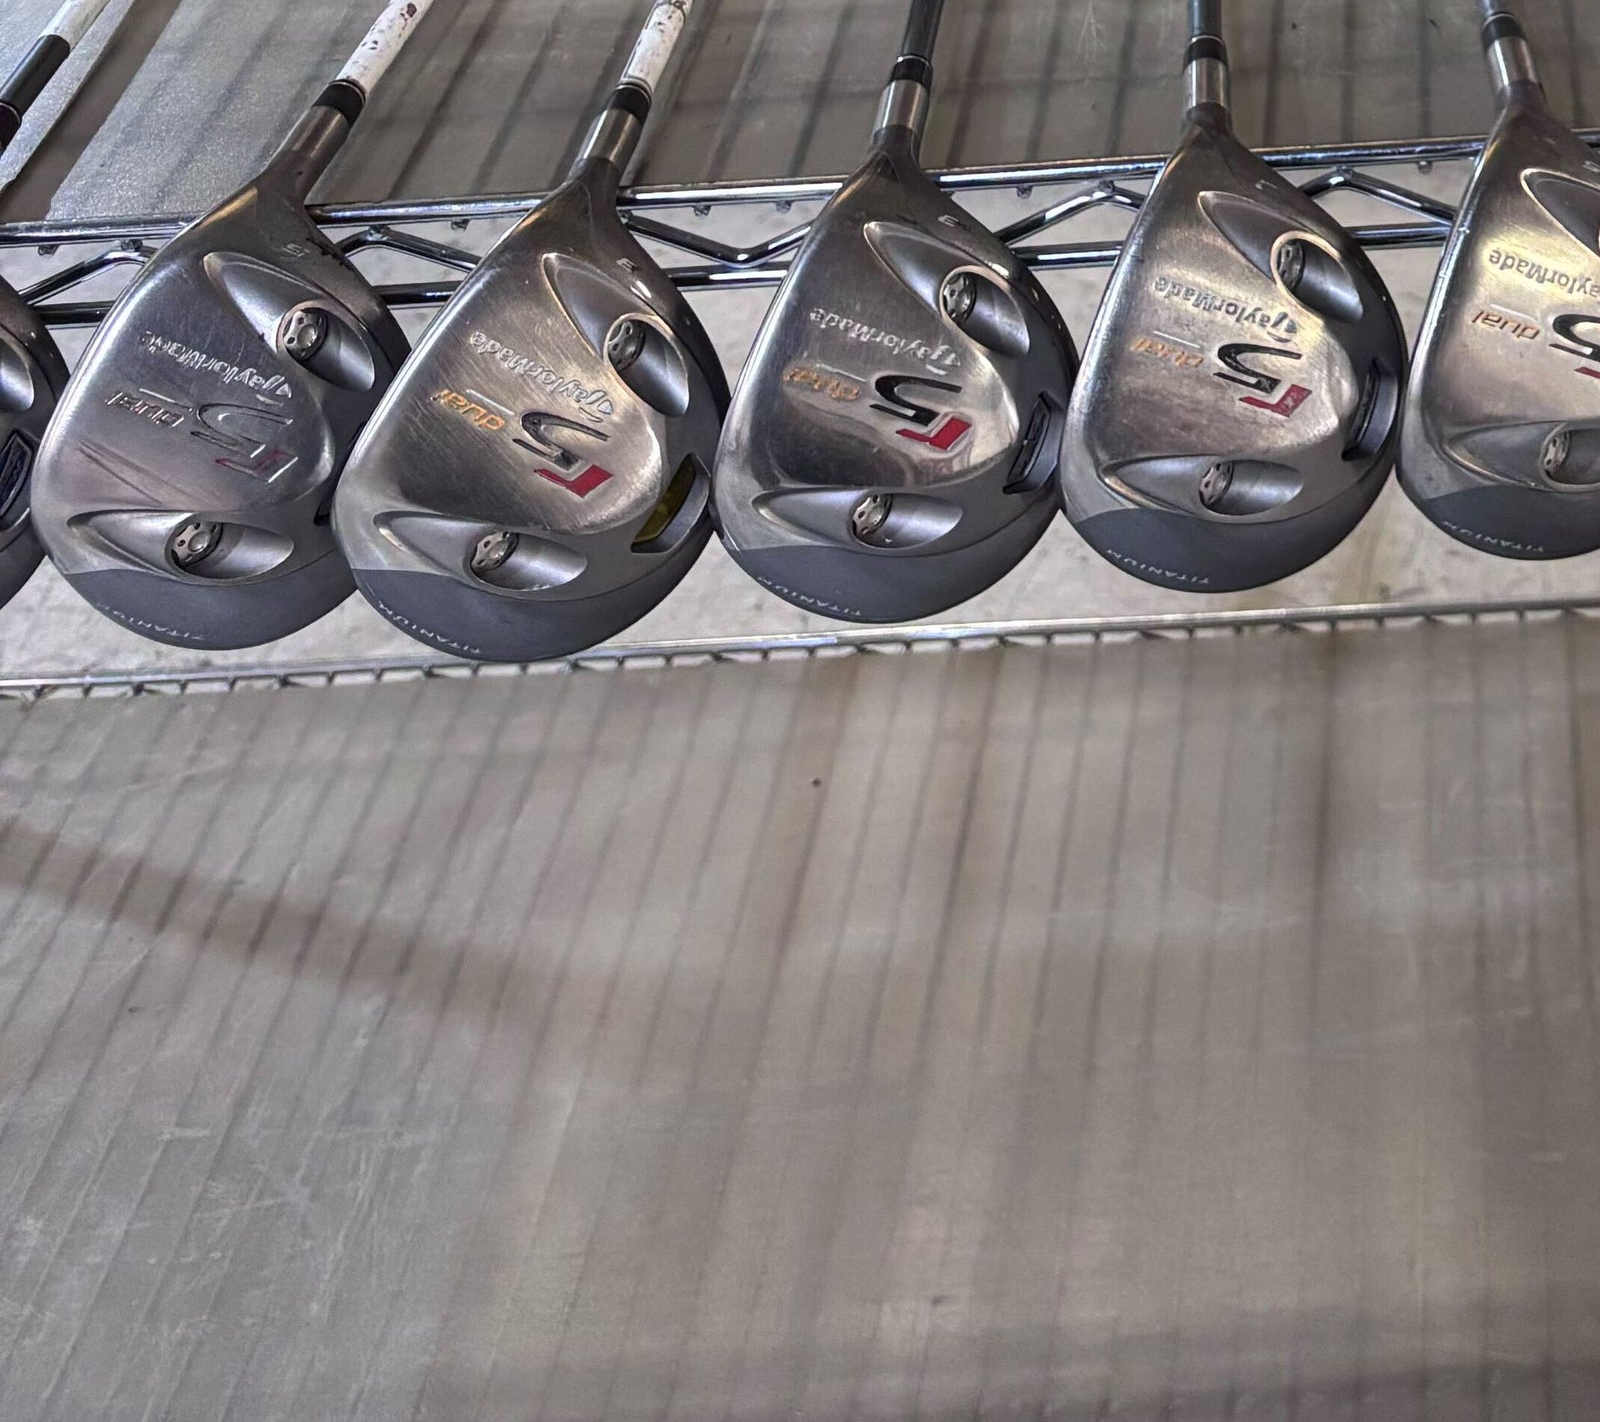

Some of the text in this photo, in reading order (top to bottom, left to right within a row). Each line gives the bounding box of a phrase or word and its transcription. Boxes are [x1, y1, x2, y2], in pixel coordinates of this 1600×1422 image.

[809, 307, 962, 376] TaylorMade
[1153, 275, 1299, 343] TaylorMade
[1471, 310, 1542, 341] dual
[469, 331, 615, 424] TaylorMade
